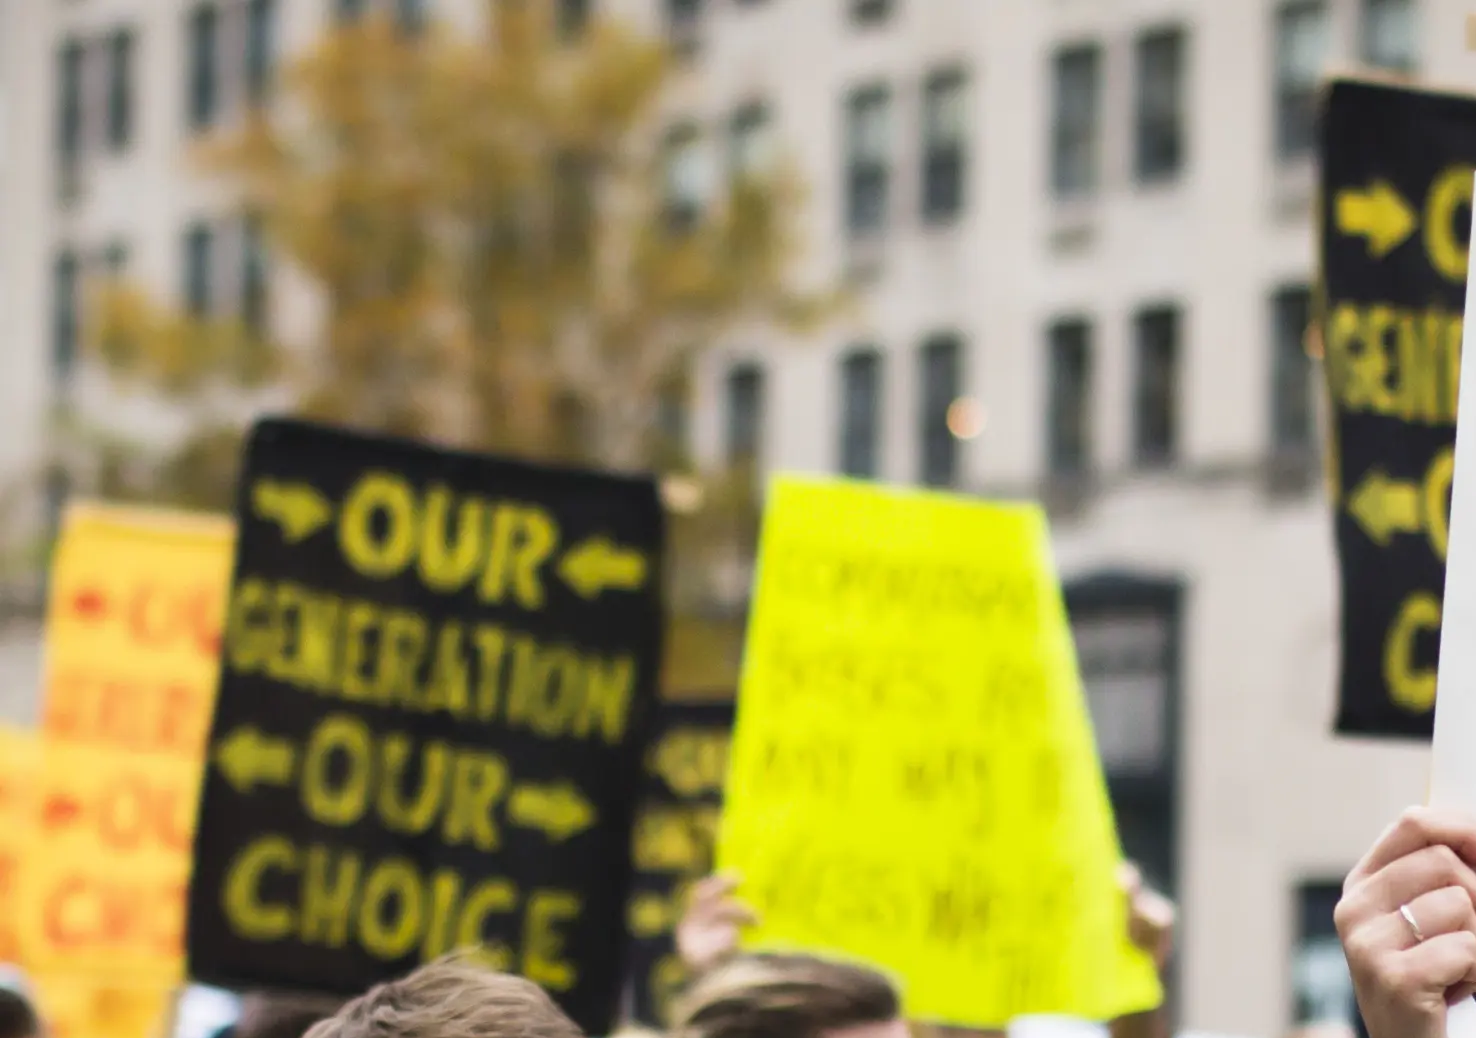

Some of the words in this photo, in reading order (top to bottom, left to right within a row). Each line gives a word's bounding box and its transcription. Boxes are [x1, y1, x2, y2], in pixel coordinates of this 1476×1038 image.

[337, 472, 560, 607] OUR
[227, 578, 636, 743] GENERATION
[303, 715, 512, 850] OUR
[223, 836, 580, 992] CHOICE
